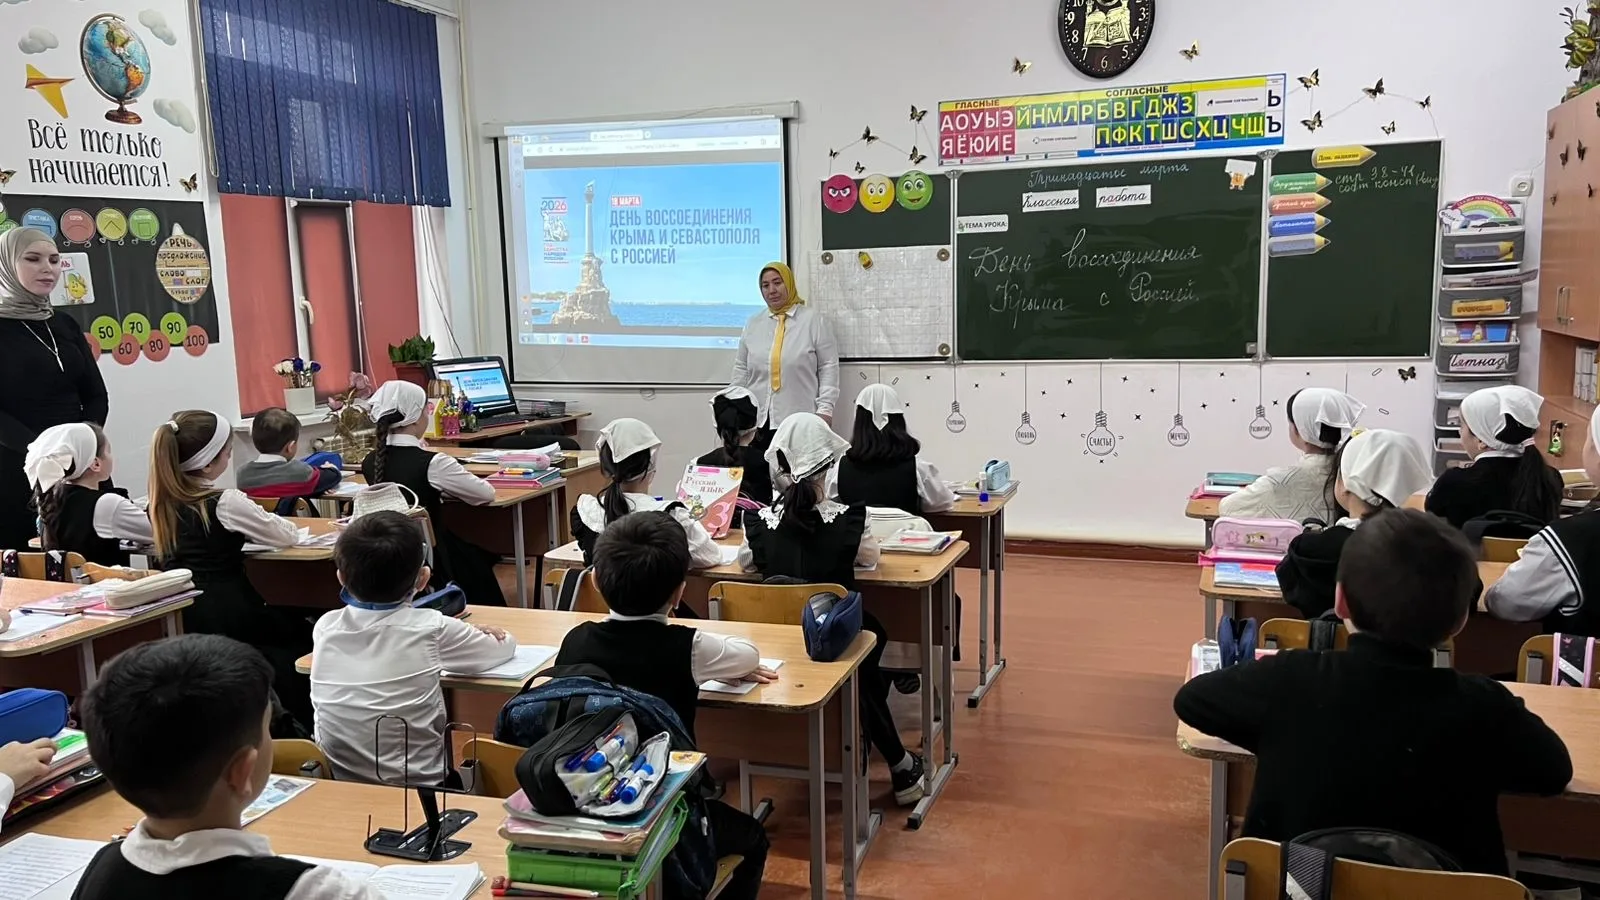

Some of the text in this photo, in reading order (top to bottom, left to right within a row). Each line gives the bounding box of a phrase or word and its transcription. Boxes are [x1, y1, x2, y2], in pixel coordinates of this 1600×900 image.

[1067, 12, 1075, 25] 9
[1138, 7, 1146, 21] 3
[1072, 30, 1079, 43] 8
[1133, 26, 1140, 40] 4
[1081, 47, 1088, 60] 7
[1121, 45, 1129, 59] 5
[1101, 55, 1108, 69] 6
[1106, 85, 1169, 98] СОГЛАСНЫЕ
[1267, 90, 1281, 107] Ь
[955, 99, 1000, 109] ГЛАСНЫЕ
[1266, 116, 1282, 133] Ъ
[27, 118, 163, 160] Всё только
[28, 158, 171, 188] начинается!
[1140, 163, 1190, 181] марта
[541, 200, 568, 211] 2026
[619, 195, 641, 206] МАРТА
[1022, 188, 1147, 209] Классная работа
[610, 207, 752, 228] ДЕНЬ ВОССОЕДИНЕНИЯ
[169, 238, 192, 247] РЕЧЬ
[610, 227, 760, 246] КРЫМА И СЕВАСТОПОЛЯ
[611, 245, 676, 264] С РОССИЕЙ
[968, 246, 1032, 277] День
[989, 280, 1070, 329] Крыма
[98, 325, 114, 340] 50
[129, 321, 143, 334] 70
[167, 321, 181, 335] 90
[148, 338, 164, 353] 80
[186, 334, 206, 348] 100
[118, 342, 133, 355] 60
[707, 501, 733, 529] 3
